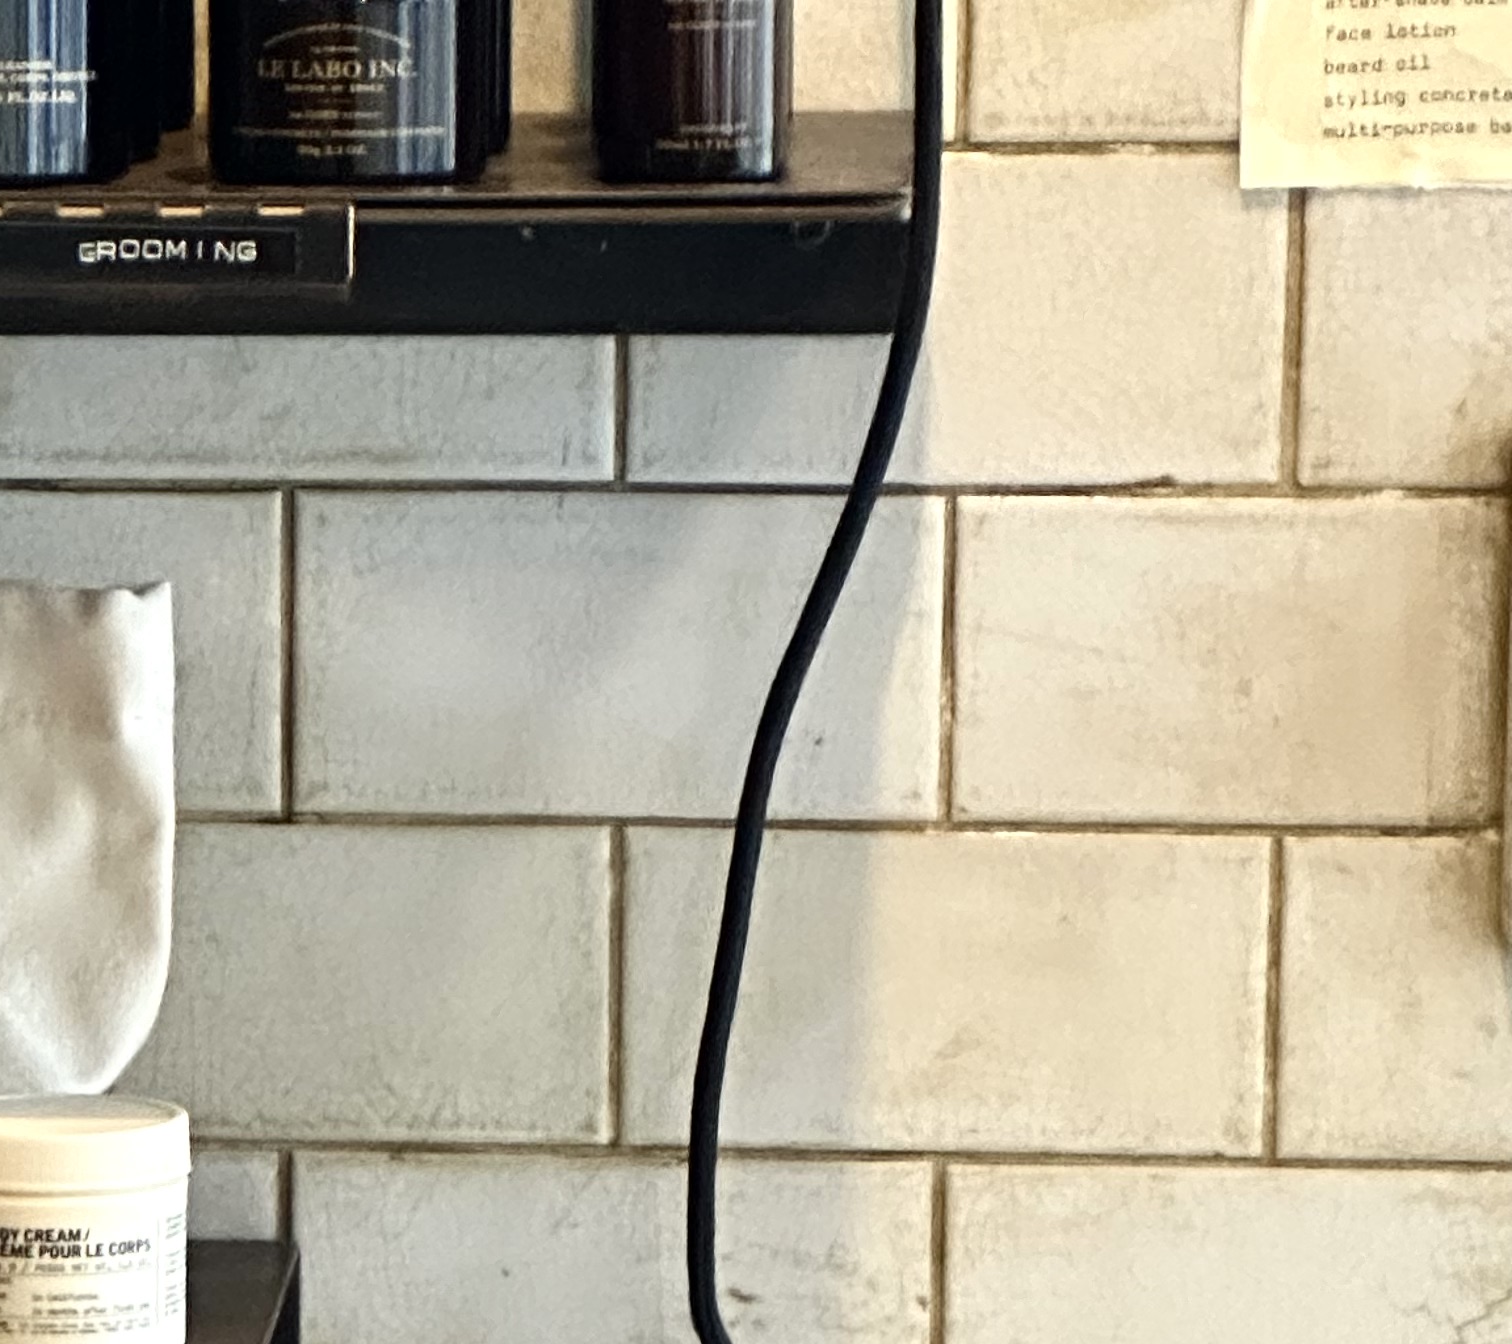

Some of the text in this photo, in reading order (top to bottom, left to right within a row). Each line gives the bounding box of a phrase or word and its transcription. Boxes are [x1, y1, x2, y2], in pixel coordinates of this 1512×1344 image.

[1385, 22, 1457, 39] lotion
[257, 58, 286, 78] LE
[291, 59, 362, 79] LABO
[1324, 54, 1432, 75] beard oil
[1323, 90, 1406, 109] styling
[1323, 119, 1478, 139] multi-purpose
[77, 238, 257, 263] GROOMING
[38, 1244, 82, 1259] POUR
[85, 1242, 104, 1258] LE
[108, 1238, 152, 1256] CORPS
